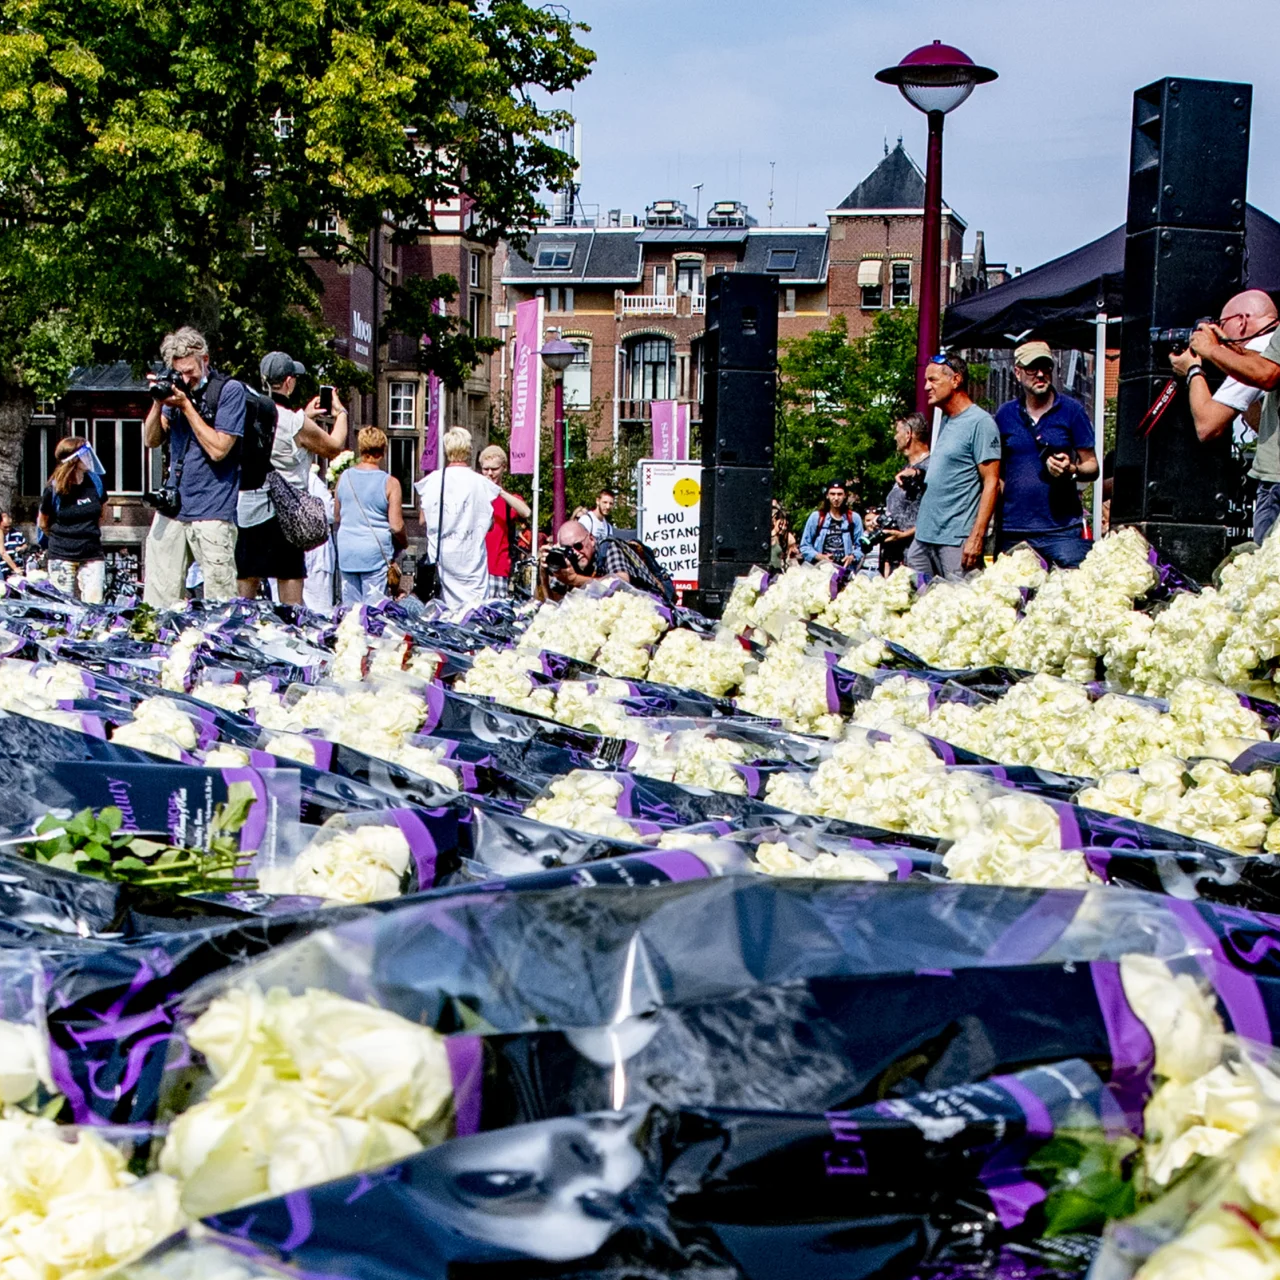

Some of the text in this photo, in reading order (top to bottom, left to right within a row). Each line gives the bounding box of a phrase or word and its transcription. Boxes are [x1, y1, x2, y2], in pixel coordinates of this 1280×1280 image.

[513, 343, 532, 428] Banksy
[657, 512, 685, 525] HOU
[644, 526, 700, 542] AFSTAND
[680, 543, 697, 555] BIJ
[660, 559, 698, 572] RUKTE
